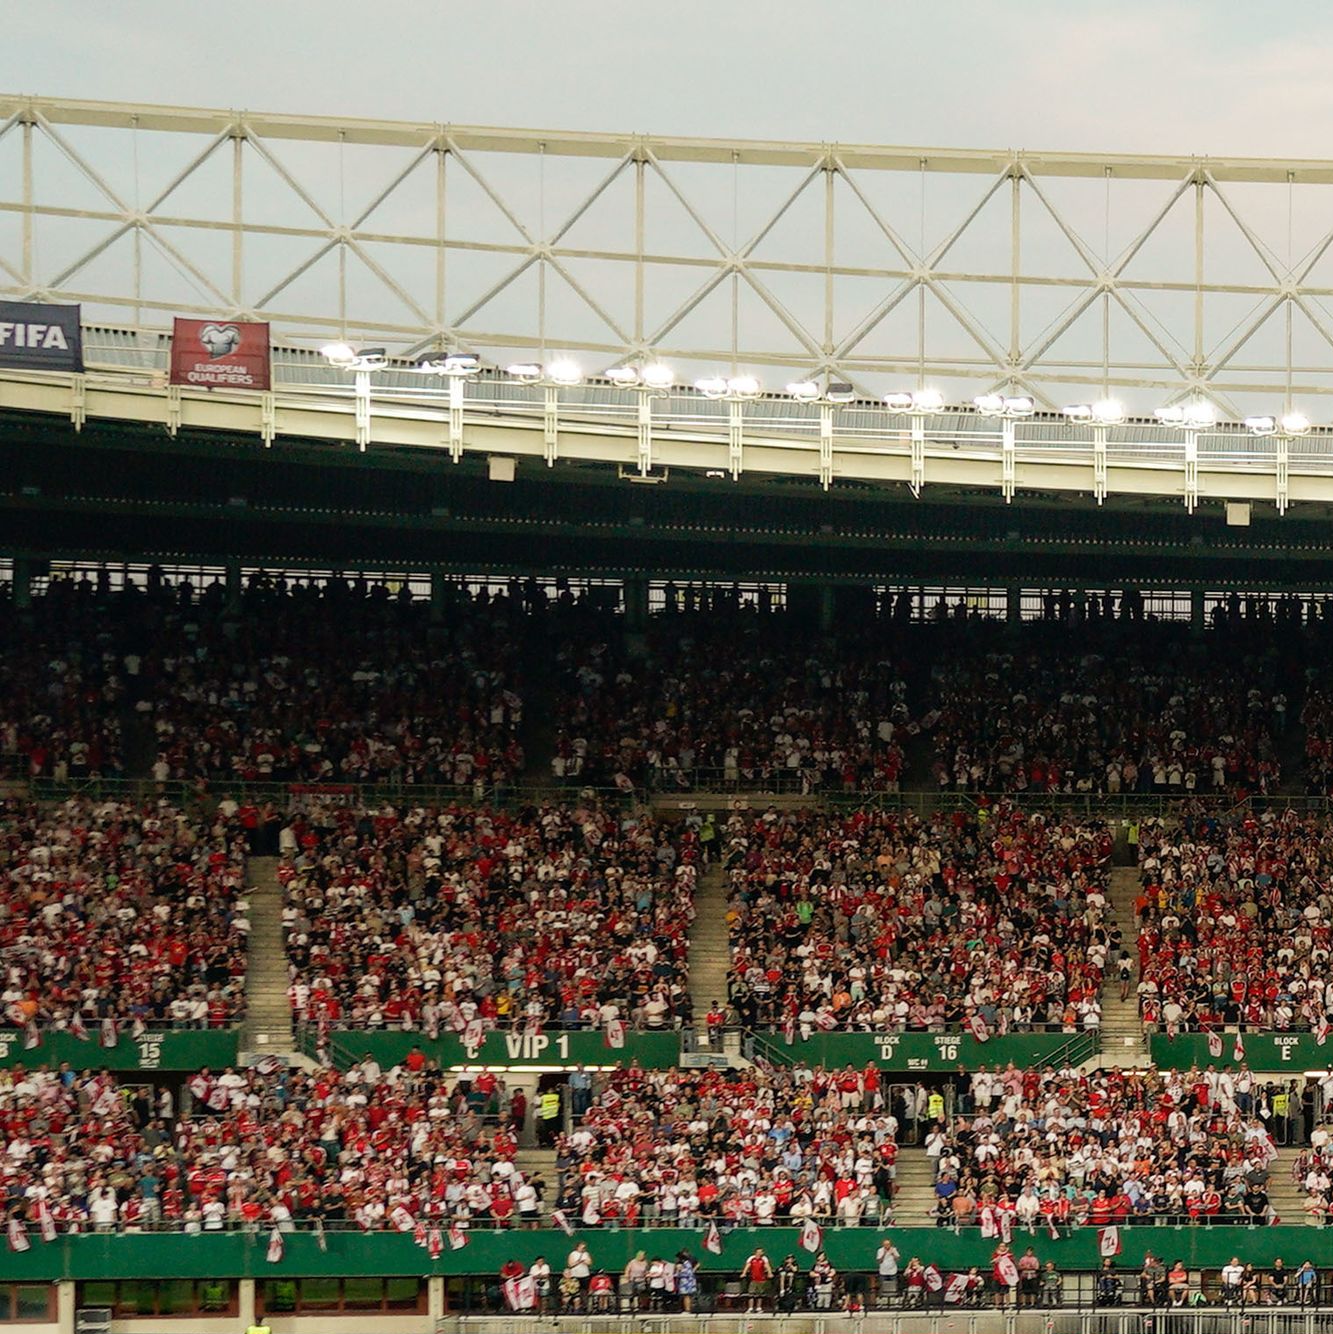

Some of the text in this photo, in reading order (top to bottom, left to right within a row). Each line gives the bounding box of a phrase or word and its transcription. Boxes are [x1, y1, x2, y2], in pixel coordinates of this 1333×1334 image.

[0, 322, 68, 349] FIFA
[194, 364, 247, 374] EUROPEAN
[187, 373, 253, 385] QUALIFIERS
[874, 1036, 900, 1044] BLOCK
[934, 1037, 961, 1045] STIEGE
[1274, 1037, 1299, 1045] BLOCK
[139, 1043, 160, 1058] 15
[506, 1035, 569, 1058] VIP 1
[938, 1046, 957, 1060] 16
